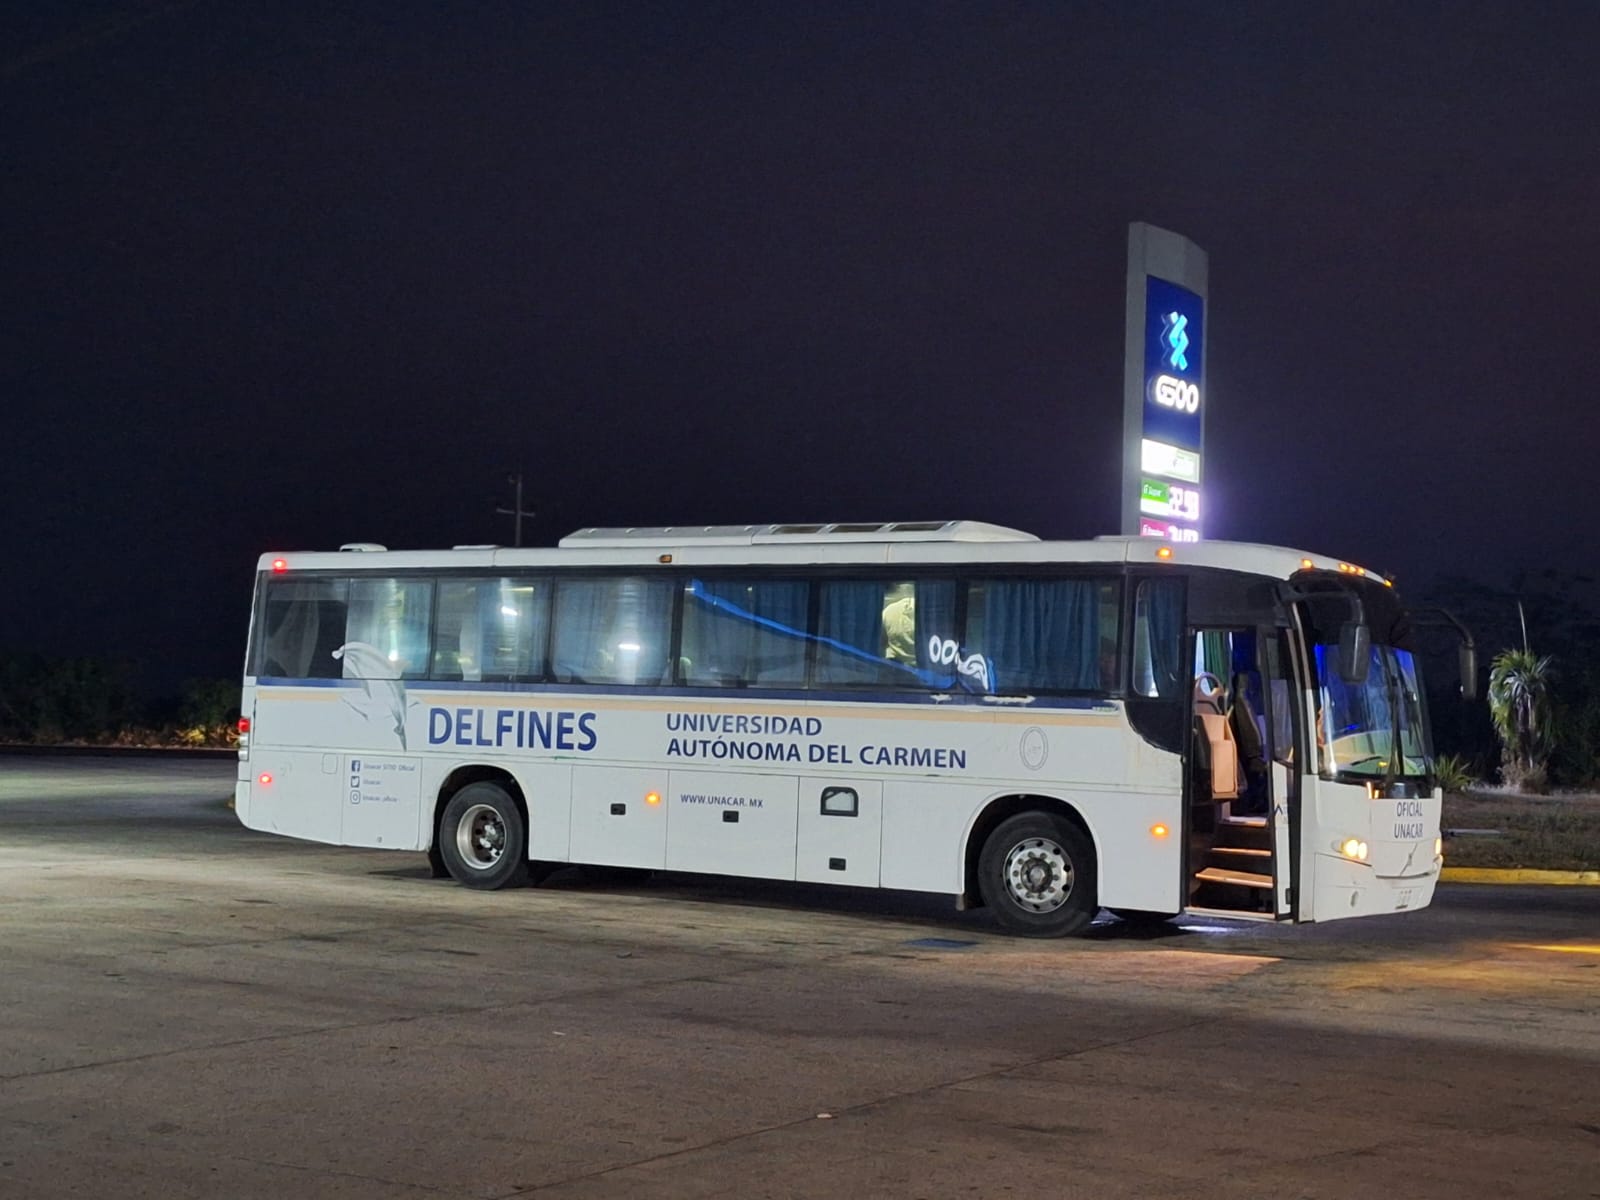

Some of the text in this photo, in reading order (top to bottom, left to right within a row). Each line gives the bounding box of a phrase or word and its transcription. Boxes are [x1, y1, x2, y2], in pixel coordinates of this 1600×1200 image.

[428, 707, 597, 751] DELFINES
[666, 713, 823, 736] UNIVERSIDAD
[666, 736, 967, 769] AUTÓNOMA DEL CARMEN
[1396, 801, 1423, 817] OFICIAL
[1394, 823, 1424, 839] UNACAR
